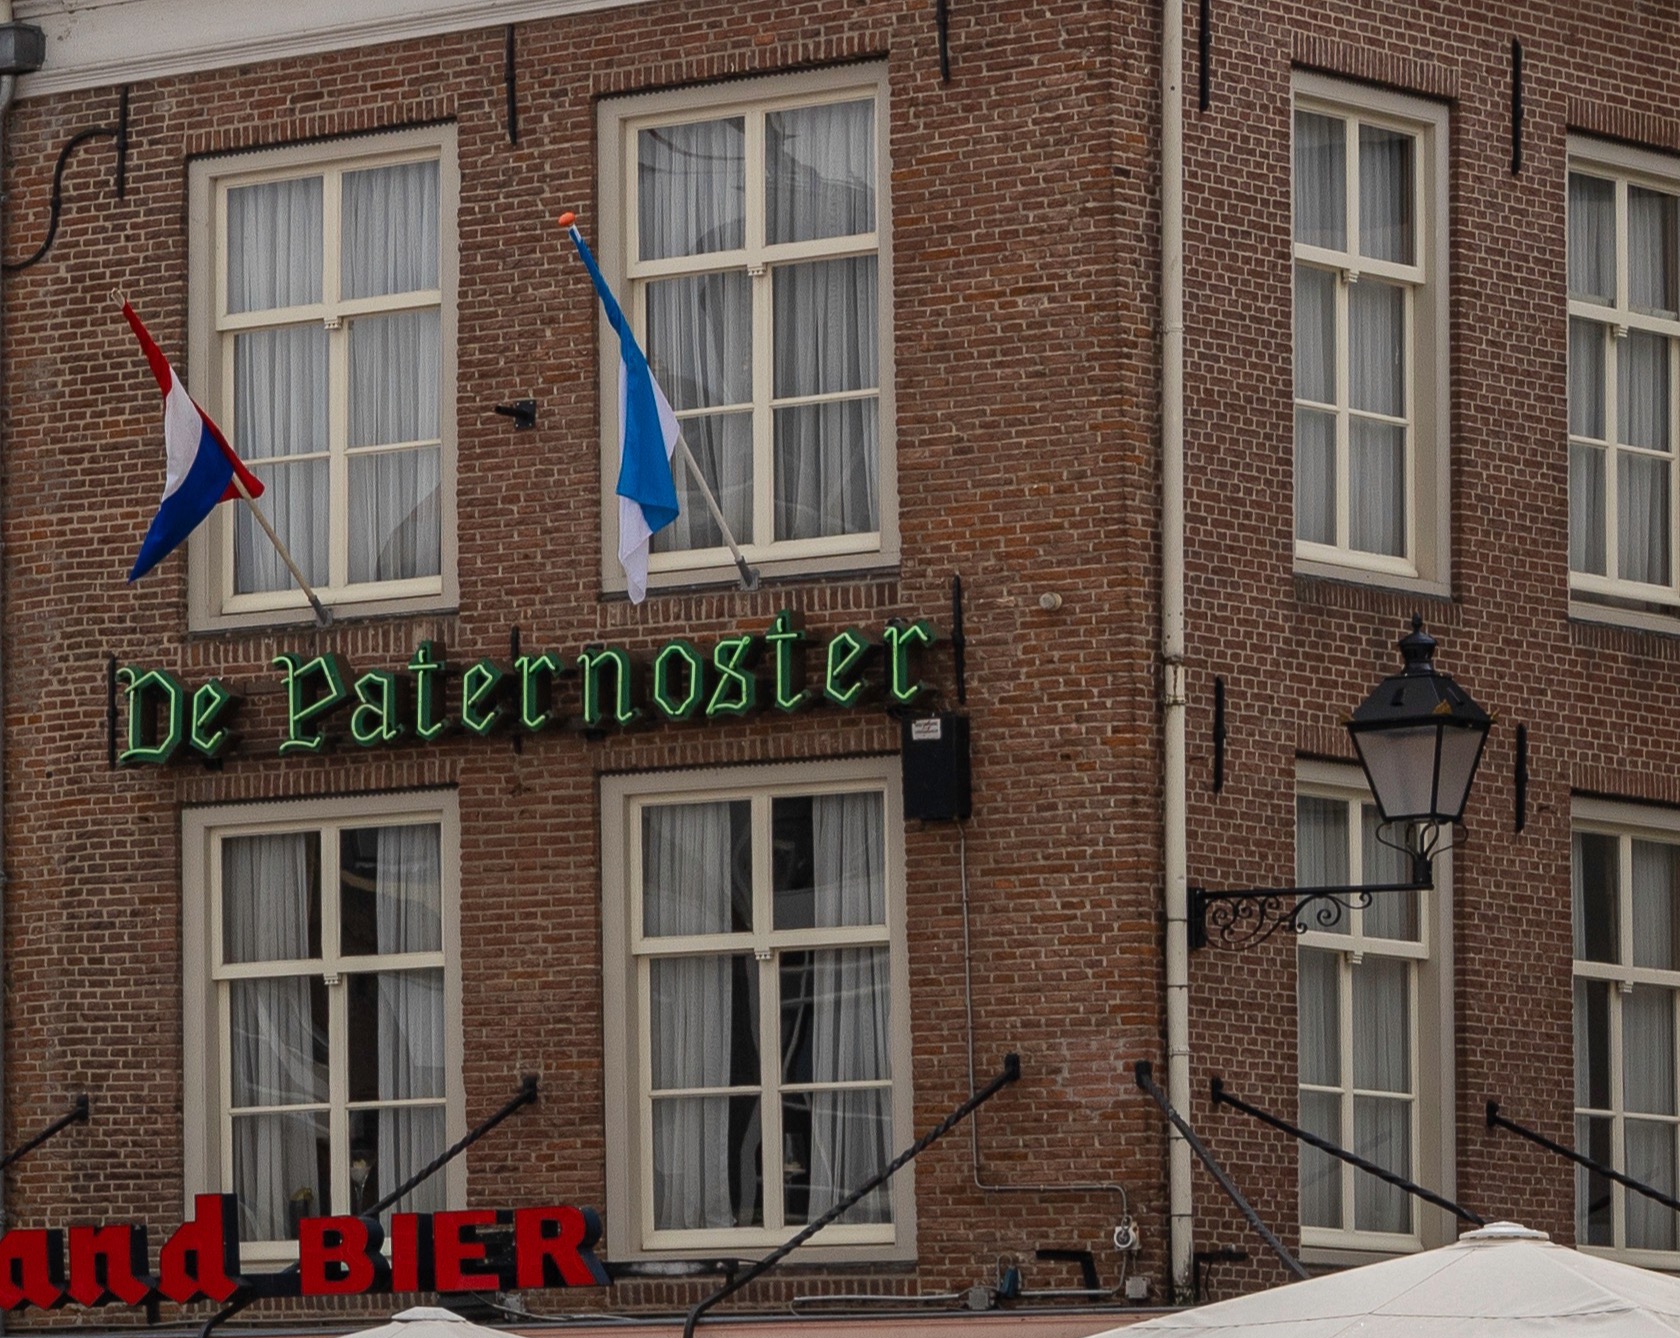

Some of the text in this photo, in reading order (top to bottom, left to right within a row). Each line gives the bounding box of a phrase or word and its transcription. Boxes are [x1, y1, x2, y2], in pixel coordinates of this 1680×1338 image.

[118, 608, 942, 766] De Paternoster
[299, 1206, 605, 1296] BIER
